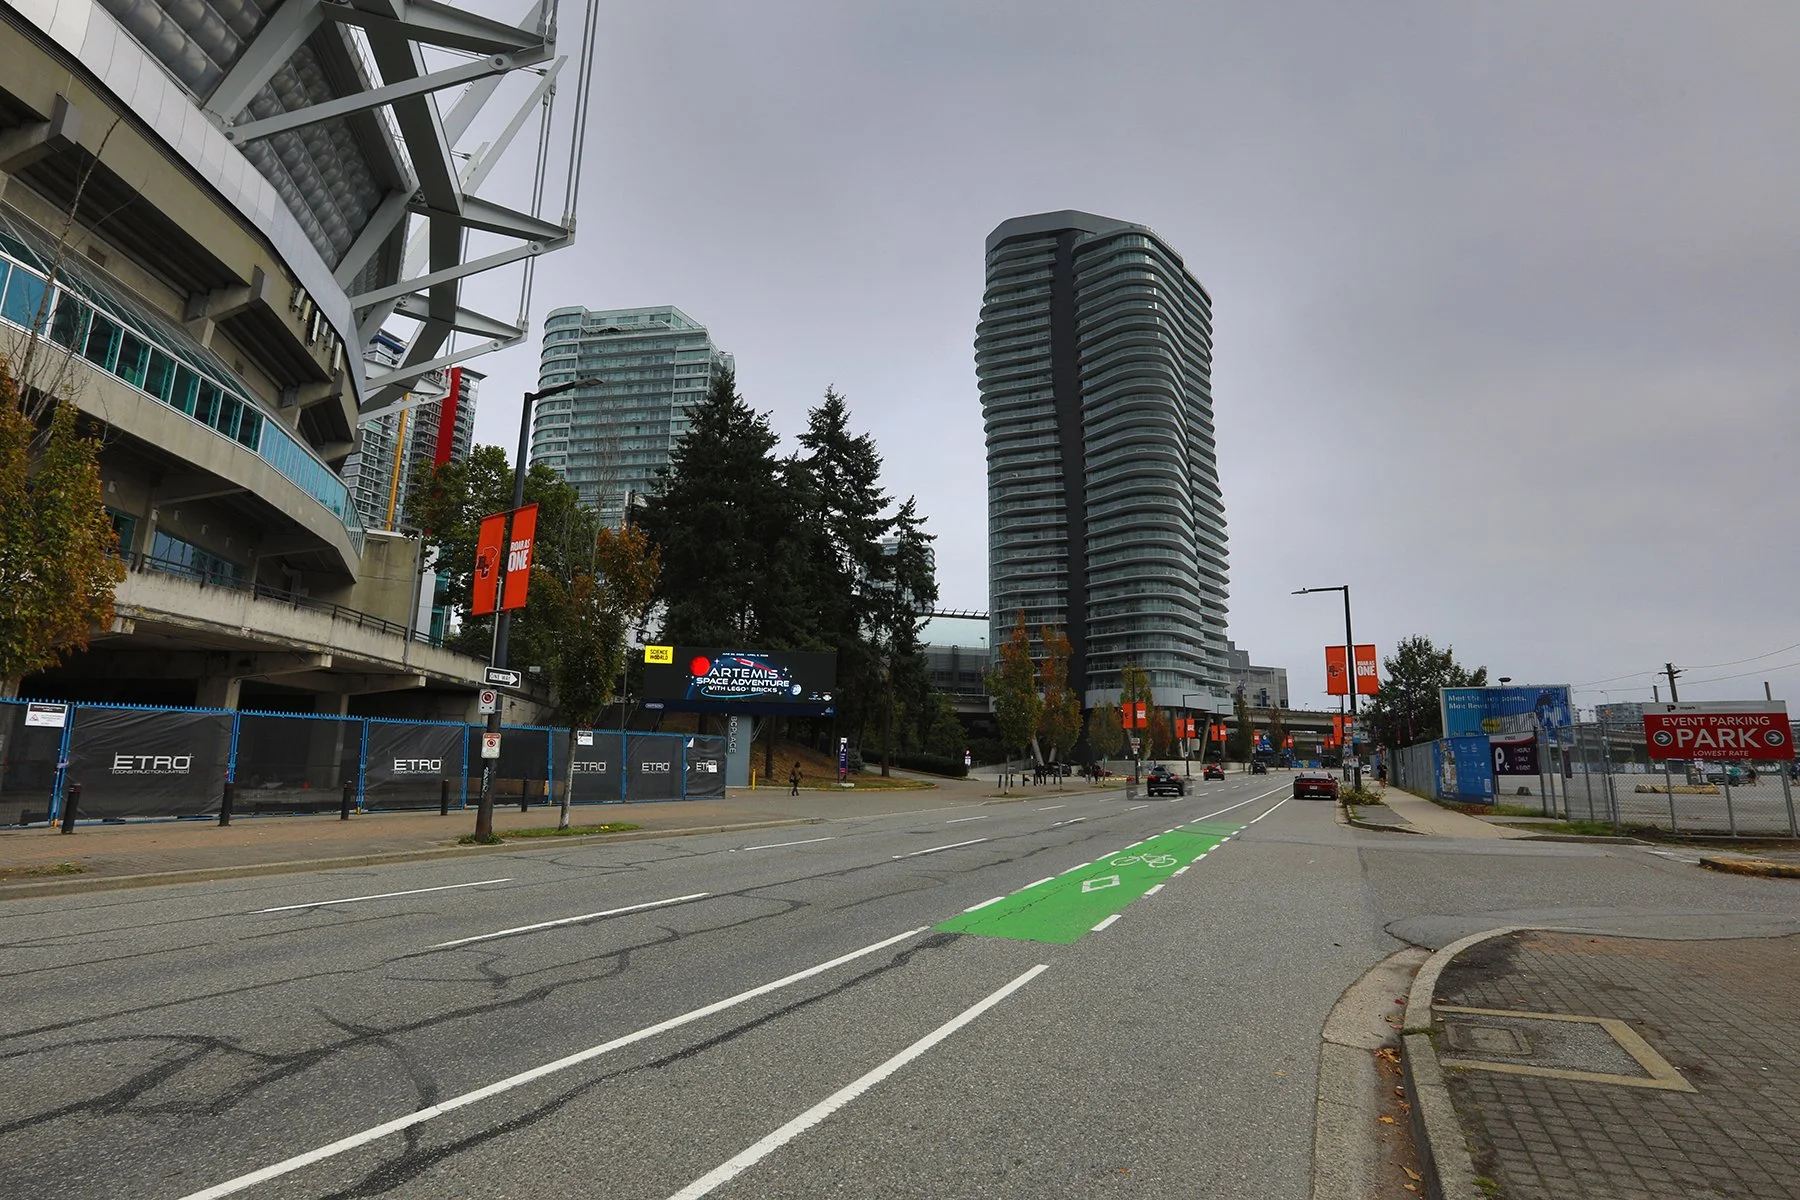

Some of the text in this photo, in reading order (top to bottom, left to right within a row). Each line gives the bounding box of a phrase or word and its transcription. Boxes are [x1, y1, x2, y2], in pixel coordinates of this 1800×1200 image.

[511, 540, 523, 552] ROAR
[507, 550, 529, 572] ONE
[489, 672, 499, 680] ONE
[708, 668, 778, 679] ARTEMIS
[1357, 666, 1376, 676] ONE
[696, 677, 790, 687] SPACE ADVENTURE
[1662, 716, 1770, 726] EVENT PARKING
[1676, 728, 1761, 748] PARK
[114, 755, 190, 769] ETRO
[394, 759, 441, 770] ETRO
[1495, 747, 1505, 771] P
[572, 762, 607, 771] ETRO
[642, 762, 670, 771] ETRO
